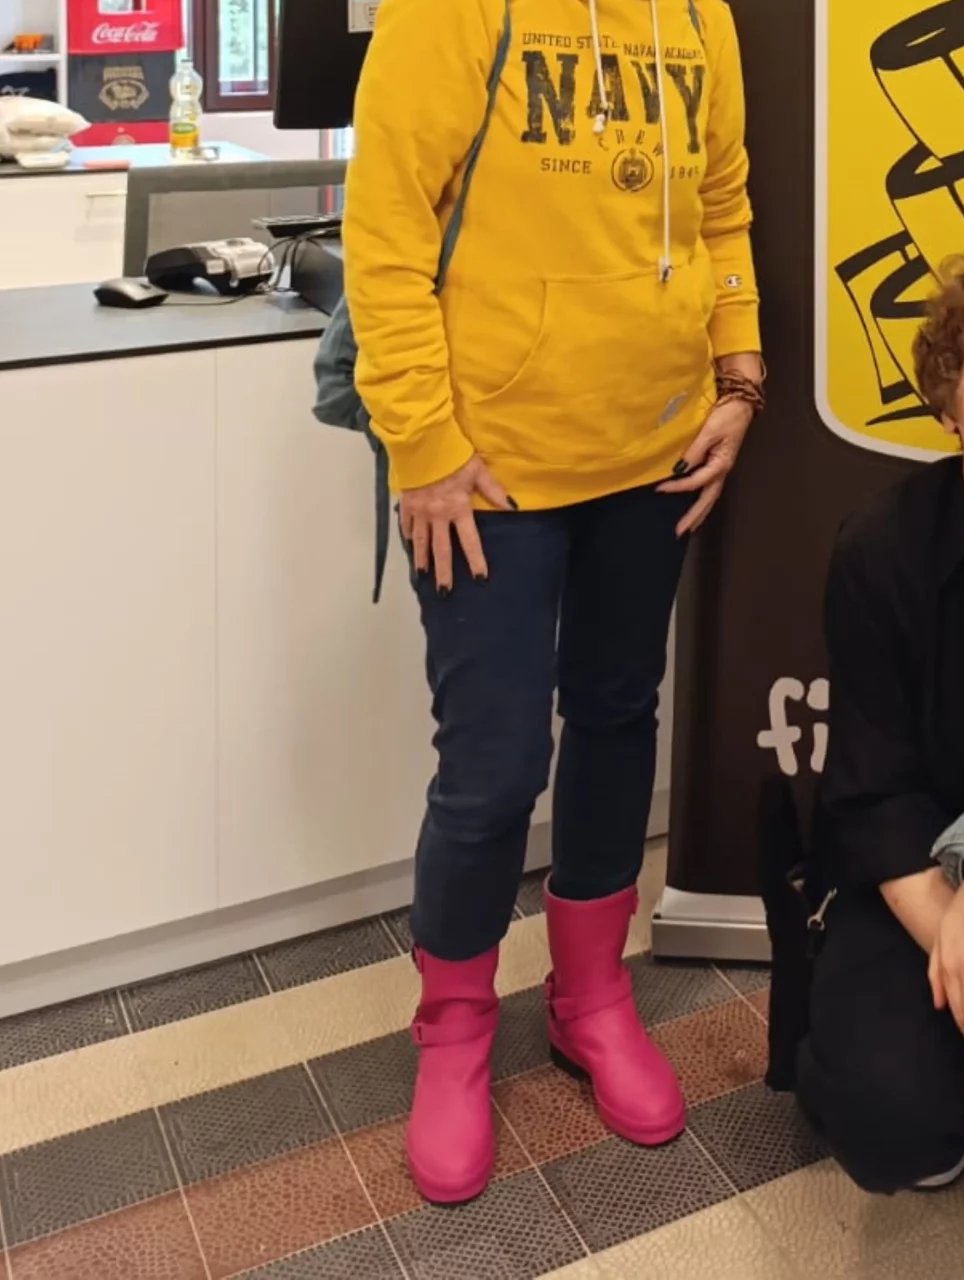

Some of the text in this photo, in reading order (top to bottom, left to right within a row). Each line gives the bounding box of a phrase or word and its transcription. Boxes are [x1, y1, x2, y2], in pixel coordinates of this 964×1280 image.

[522, 32, 572, 49] UNITED
[520, 50, 706, 154] NAVY
[540, 157, 592, 174] SINCE
